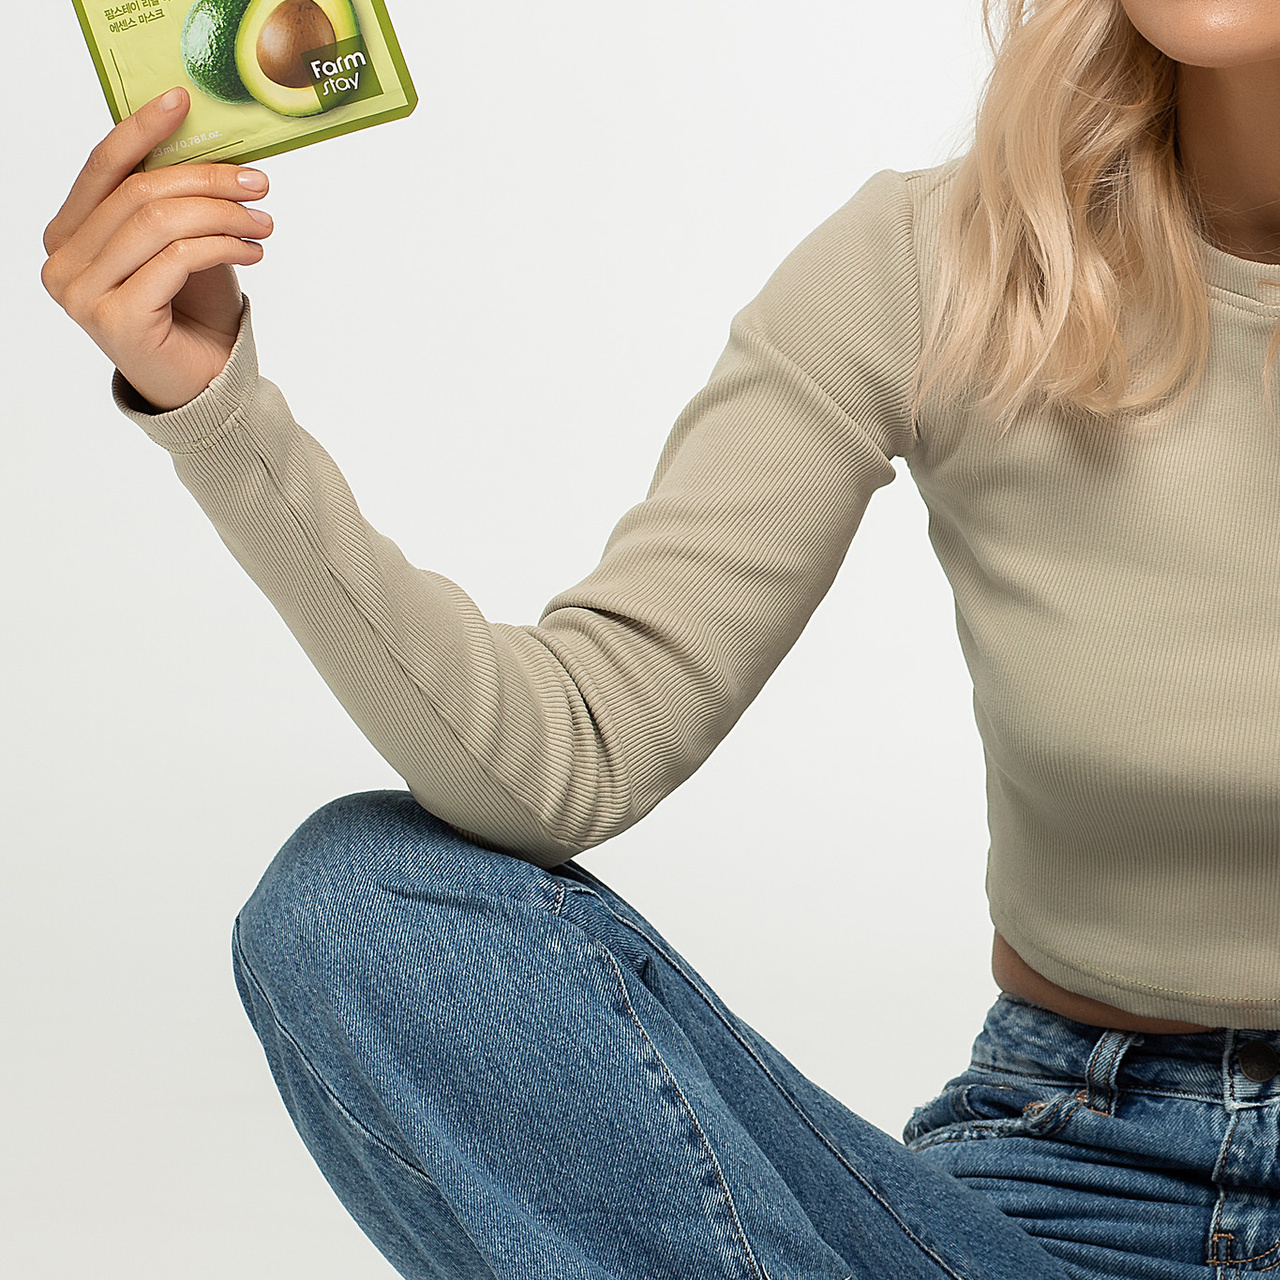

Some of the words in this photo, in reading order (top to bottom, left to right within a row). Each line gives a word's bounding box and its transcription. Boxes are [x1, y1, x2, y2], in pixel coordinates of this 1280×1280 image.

[104, 0, 141, 20] 팜스테이
[109, 18, 137, 33] 에센스
[139, 8, 165, 24] 마스크
[310, 51, 367, 79] Farm
[321, 72, 360, 96] stay
